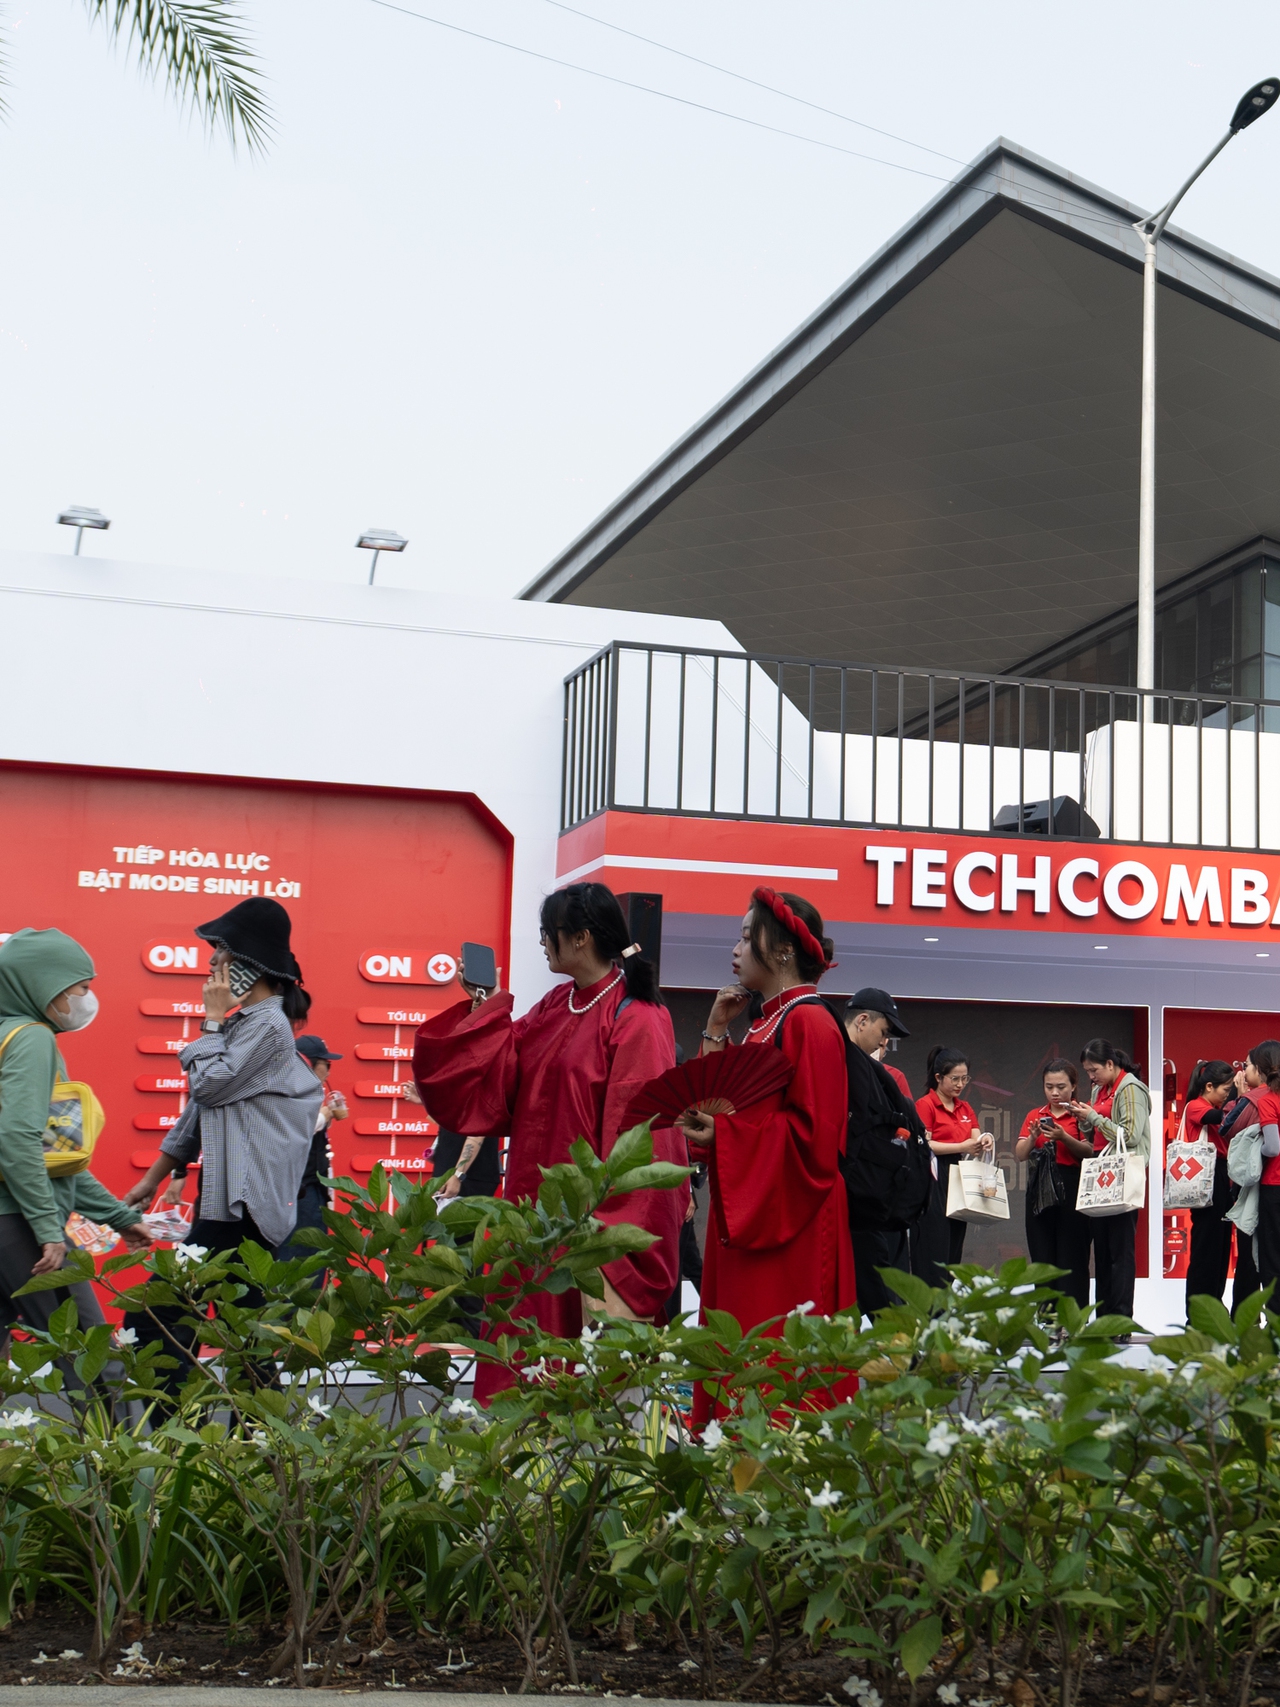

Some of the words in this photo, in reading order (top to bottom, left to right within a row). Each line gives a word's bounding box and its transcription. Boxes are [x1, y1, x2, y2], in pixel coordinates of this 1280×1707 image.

[113, 844, 165, 865] TIẾP
[225, 851, 270, 875] LỰC
[78, 868, 125, 893] BẬT
[129, 873, 199, 893] MODE
[203, 877, 259, 897] SINH
[264, 877, 301, 898] LỜI
[148, 945, 198, 969] ON
[365, 955, 412, 978] ON
[171, 1001, 193, 1013] TỐI
[387, 1010, 407, 1022] TỐI
[409, 1012, 427, 1023] ƯU
[382, 1046, 408, 1059] TIỆN
[156, 1079, 185, 1089] LINH
[374, 1084, 401, 1094] LINH
[46, 1115, 72, 1128] AG
[378, 1120, 403, 1132] BẢO
[405, 1120, 430, 1135] MẬT
[406, 1157, 426, 1170] LỜI
